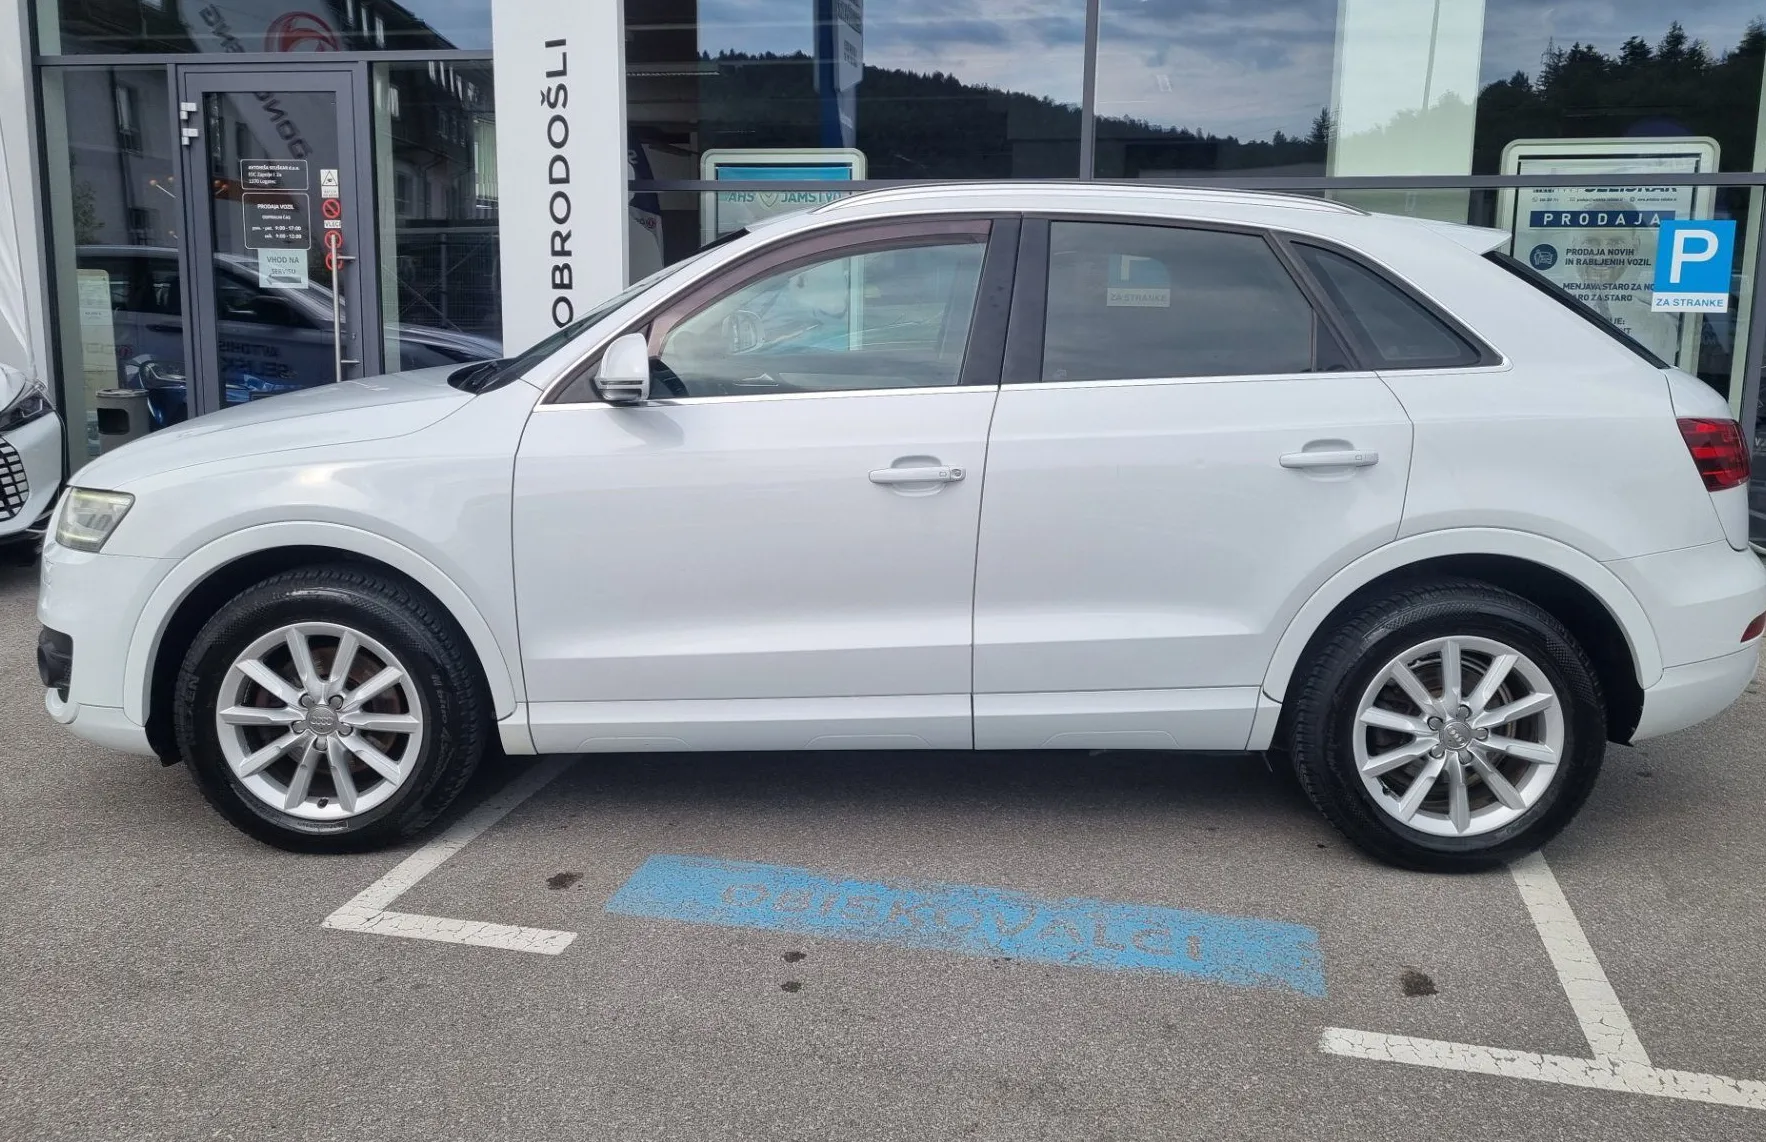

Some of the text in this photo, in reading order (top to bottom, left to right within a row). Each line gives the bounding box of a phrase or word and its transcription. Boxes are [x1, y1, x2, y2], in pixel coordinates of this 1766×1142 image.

[1543, 213, 1660, 226] PRODAJA
[1566, 248, 1635, 257] PRODAJA NOVIH
[1669, 229, 1719, 284] P
[266, 256, 300, 264] VHOD NA
[1564, 258, 1652, 266] IN RABLJENIH VOZIL
[1562, 282, 1655, 291] MENJAVA STARO ZA NO
[1656, 298, 1724, 308] ZA STRANKE
